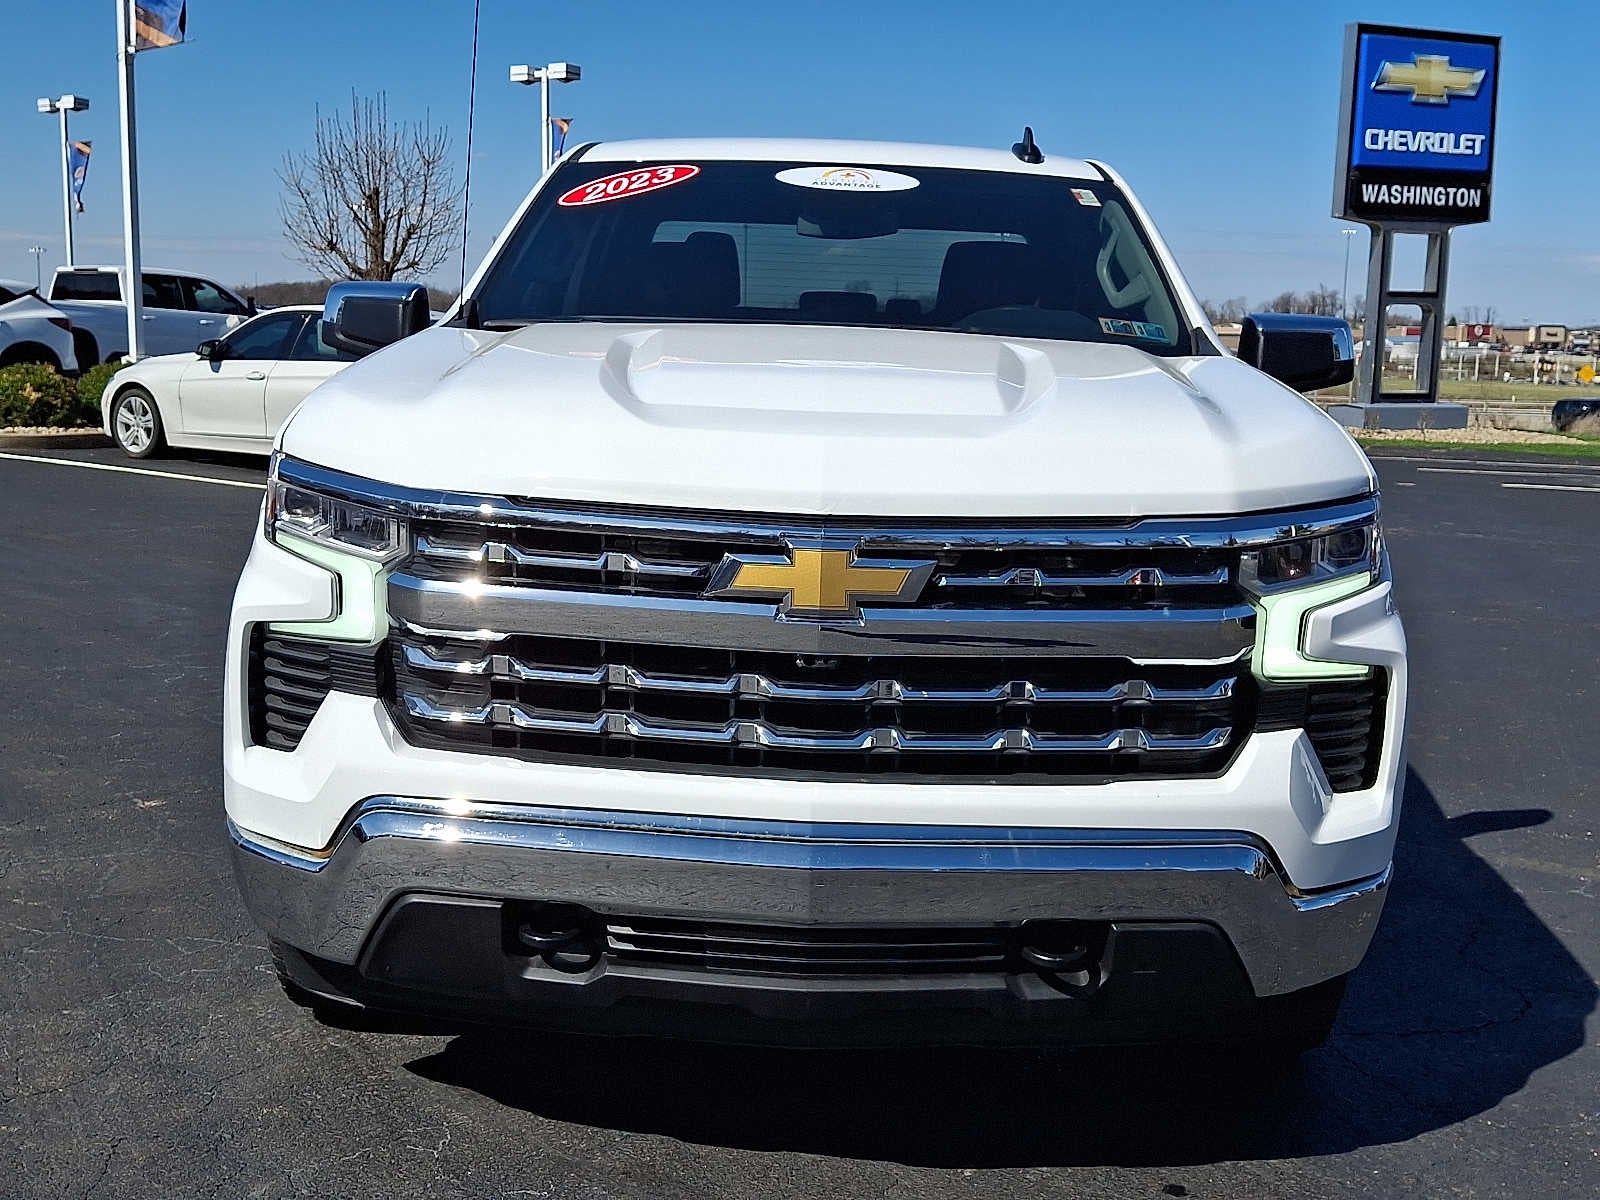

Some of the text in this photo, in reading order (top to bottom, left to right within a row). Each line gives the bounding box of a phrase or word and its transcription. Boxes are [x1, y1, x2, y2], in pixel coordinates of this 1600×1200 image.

[1364, 128, 1485, 155] CHEVROLET
[582, 167, 676, 203] 2023
[812, 181, 881, 189] ADVANTAGE
[1361, 183, 1481, 208] WASHINGTON
